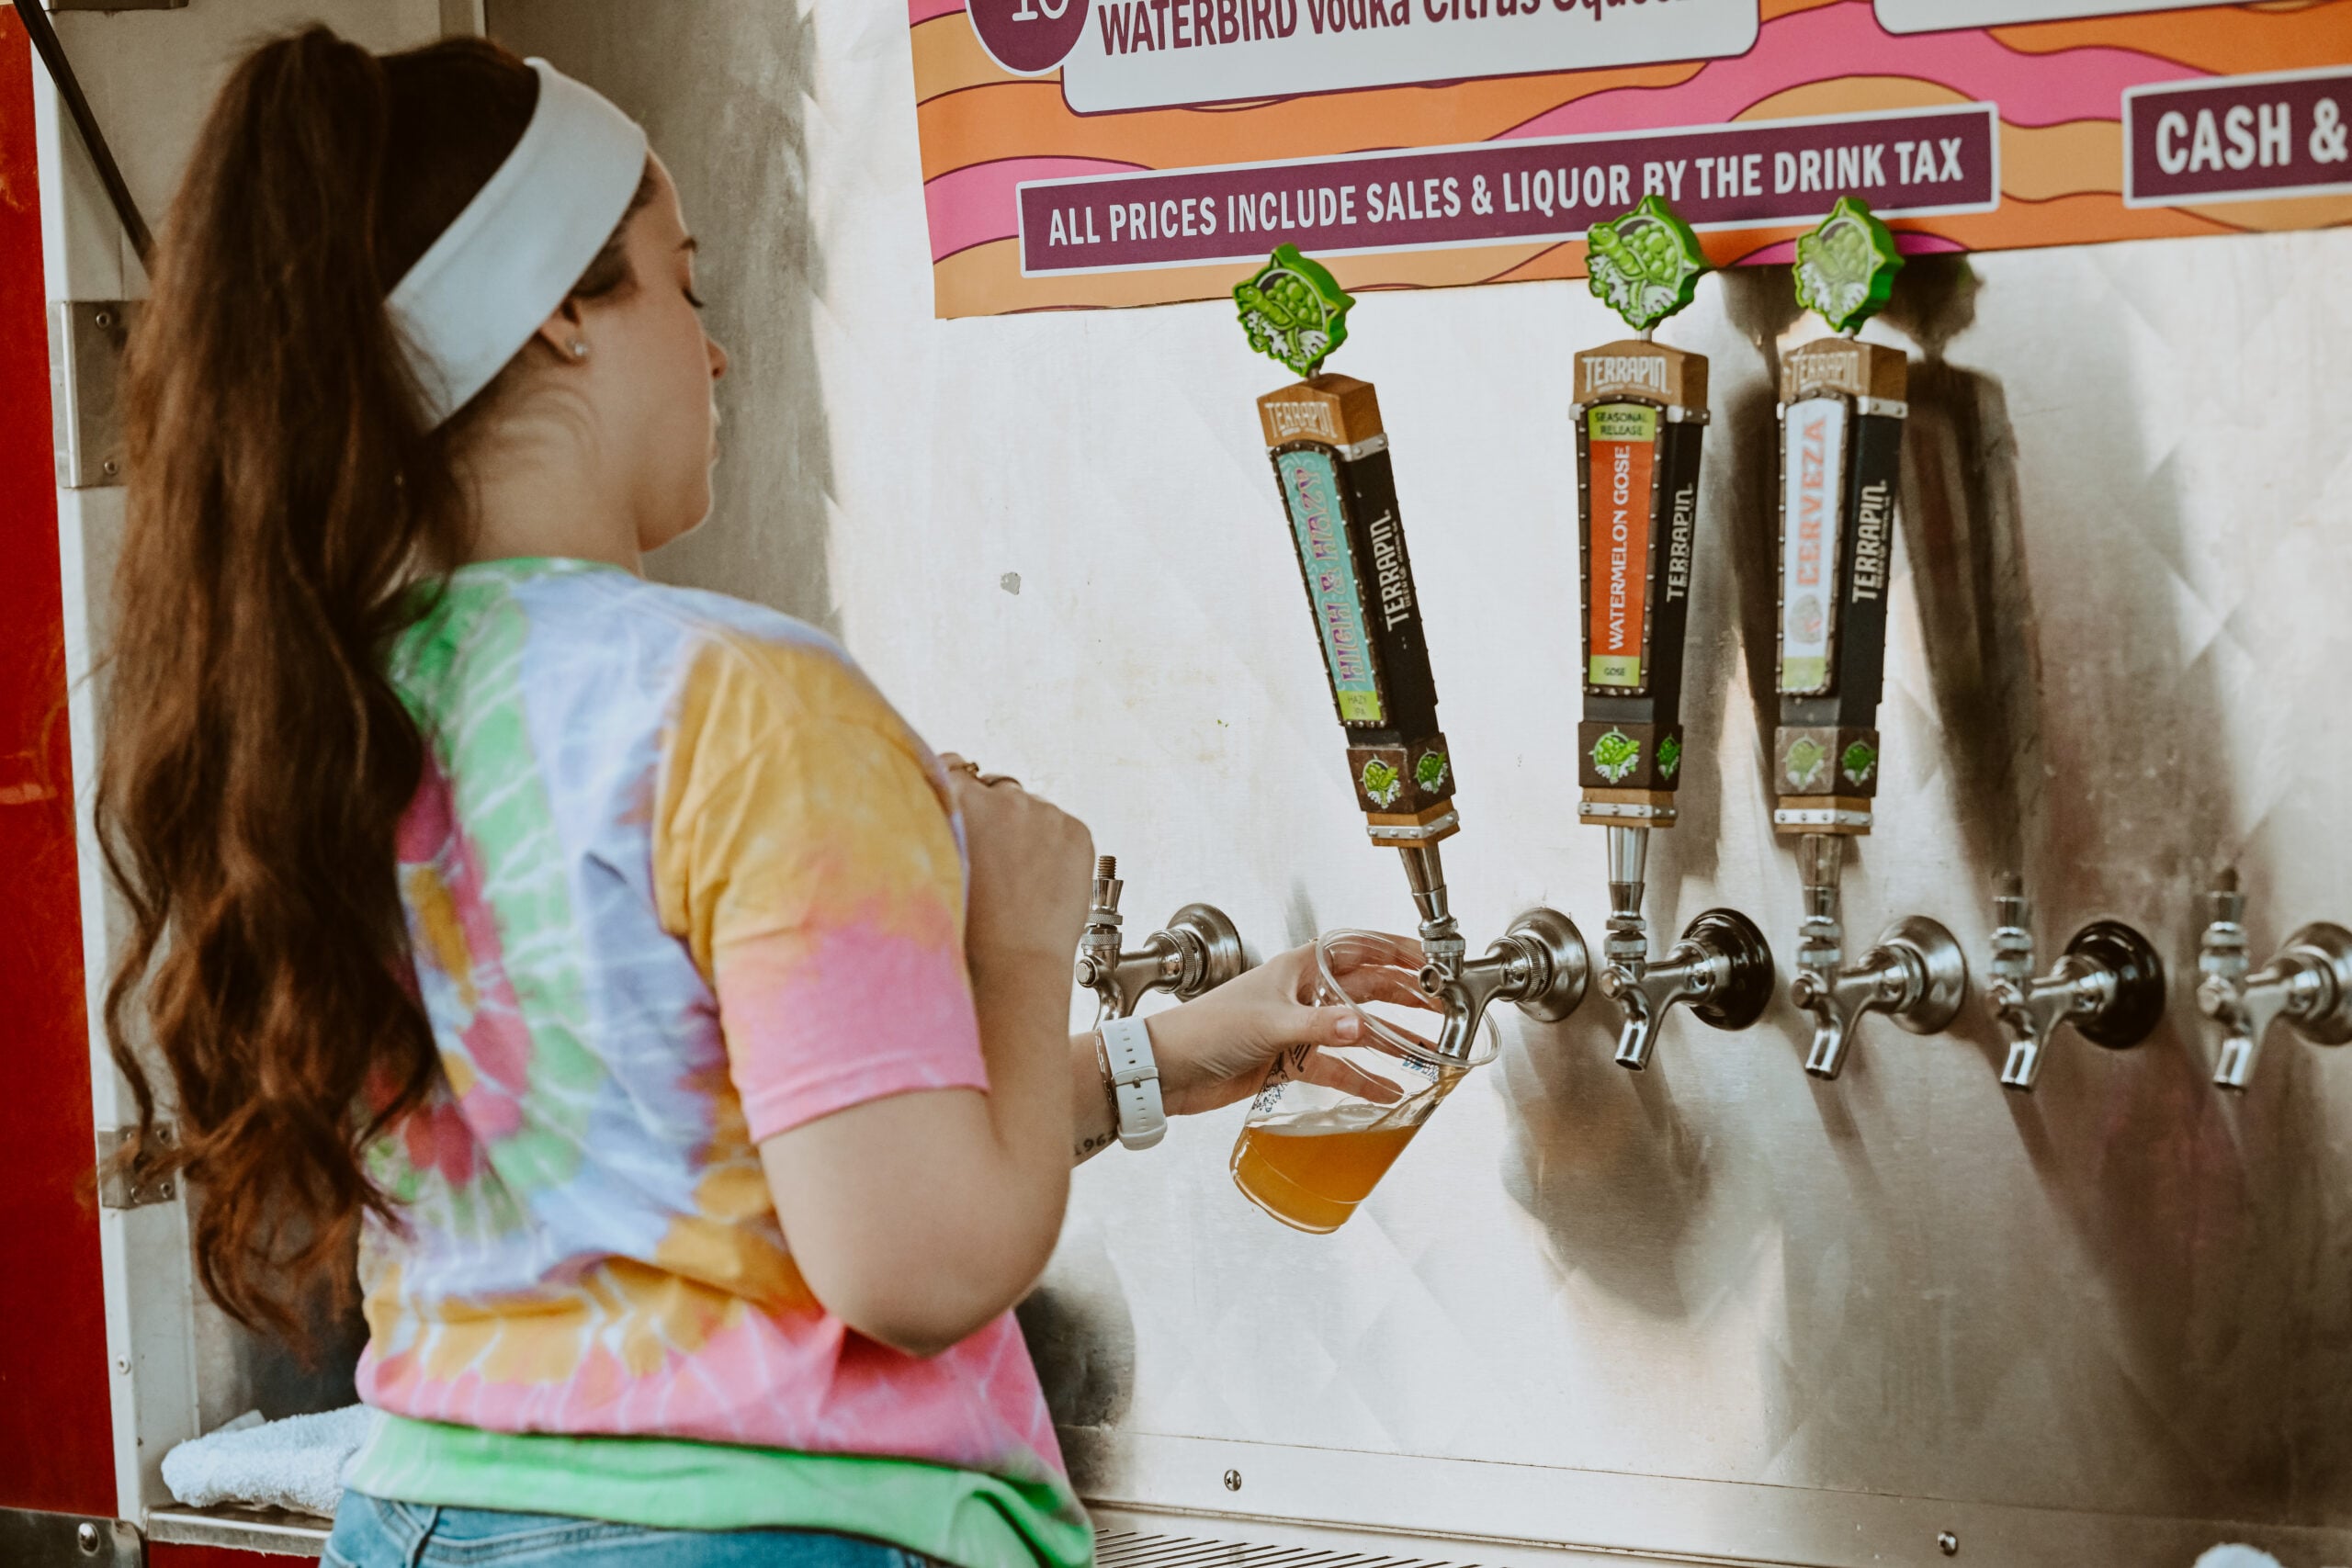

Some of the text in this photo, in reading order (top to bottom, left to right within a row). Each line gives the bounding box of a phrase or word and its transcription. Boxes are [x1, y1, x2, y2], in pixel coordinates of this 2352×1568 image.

[1098, 0, 1297, 56] WATERBIRD
[1048, 137, 1964, 247] ALL PRICES INCLUDE SALES & LIQUOR BY THE DRINK TAX
[2154, 97, 2349, 175] CASH &
[1581, 355, 1669, 394] TERRAPIN
[1608, 445, 1632, 651] WATERMELON GOSE
[1666, 488, 1694, 604] TERRAPIN
[1796, 418, 1826, 586] CERVEZA
[1851, 484, 1888, 604] TERRAPIN
[1369, 514, 1410, 633] TERRAPIN
[1326, 601, 1367, 683] HIGH
